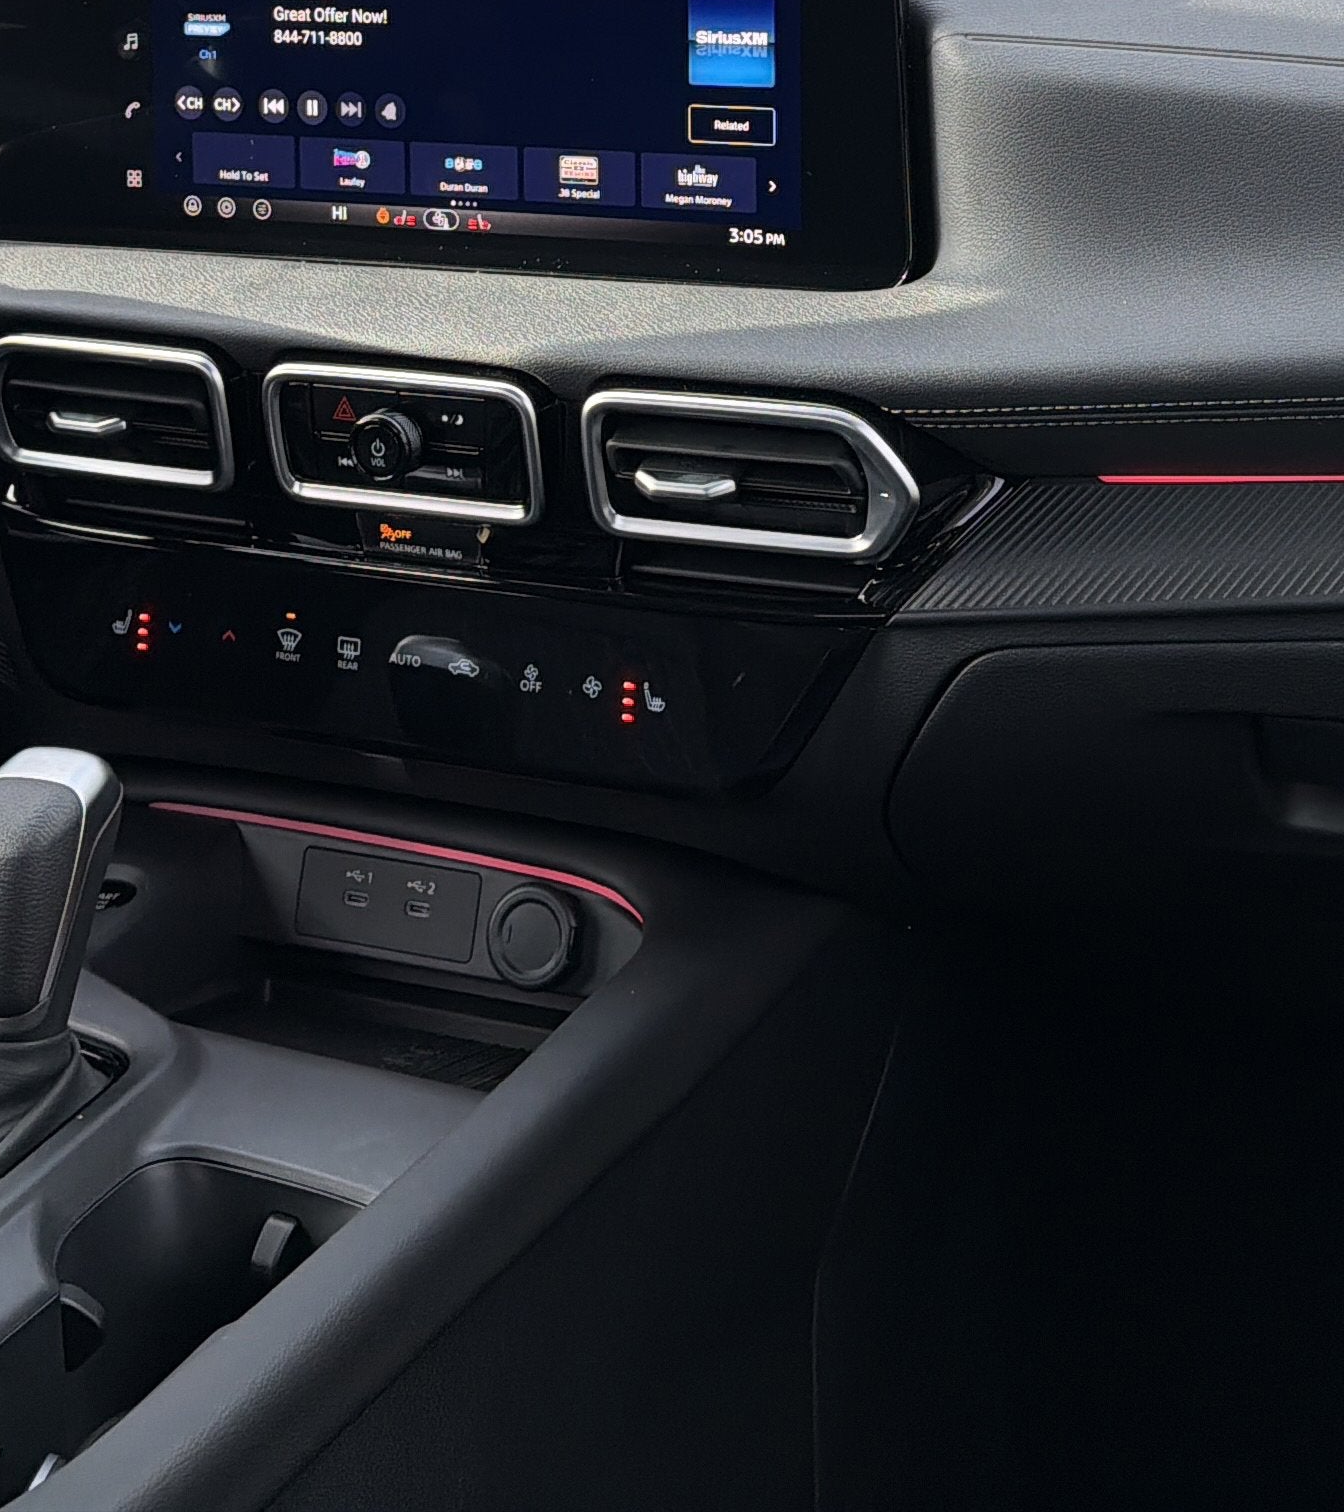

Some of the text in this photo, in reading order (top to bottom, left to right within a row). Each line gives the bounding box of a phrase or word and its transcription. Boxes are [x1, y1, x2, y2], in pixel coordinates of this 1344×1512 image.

[273, 6, 388, 24] Great Offer Now!
[273, 30, 362, 46] 844-711-8800
[695, 30, 768, 46] SiriusXM
[714, 119, 750, 132] Related
[219, 169, 268, 183] Hold To Set
[440, 182, 488, 194] Duran Duran
[571, 189, 600, 200] Special
[665, 193, 733, 209] Megan Moroney
[729, 227, 786, 246] 3:05 PM
[371, 457, 386, 468] VOL
[395, 531, 412, 539] OFF
[380, 542, 462, 560] PASSENGER AIR BAG
[276, 651, 301, 663] FRONT
[388, 654, 421, 667] AUTO
[337, 660, 358, 671] REAR
[520, 680, 542, 693] OFF
[427, 881, 436, 895] 2
